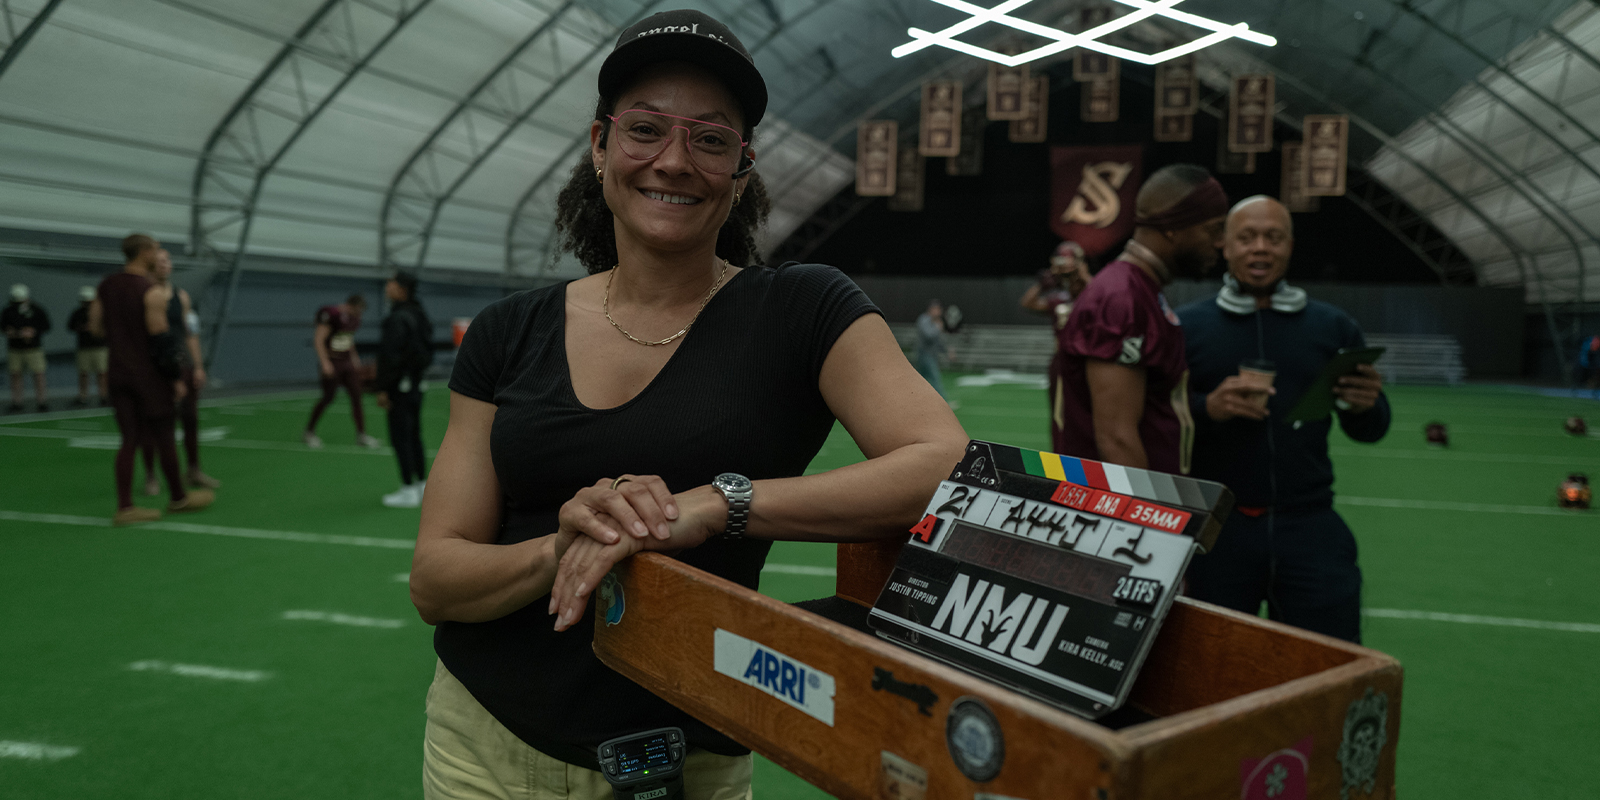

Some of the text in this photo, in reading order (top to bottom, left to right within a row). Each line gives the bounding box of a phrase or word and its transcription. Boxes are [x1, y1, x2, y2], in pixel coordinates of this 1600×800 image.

[935, 486, 982, 519] 21
[1093, 494, 1121, 516] ANA
[1130, 505, 1182, 530] 35MM
[909, 514, 938, 543] A
[888, 581, 939, 606] JUSTIN TIPPING
[907, 576, 930, 589] DIRECTOR
[930, 572, 1070, 666] NMU
[1057, 639, 1080, 656] KIRA
[743, 648, 805, 705] ARRI
[638, 789, 664, 800] KIRA
